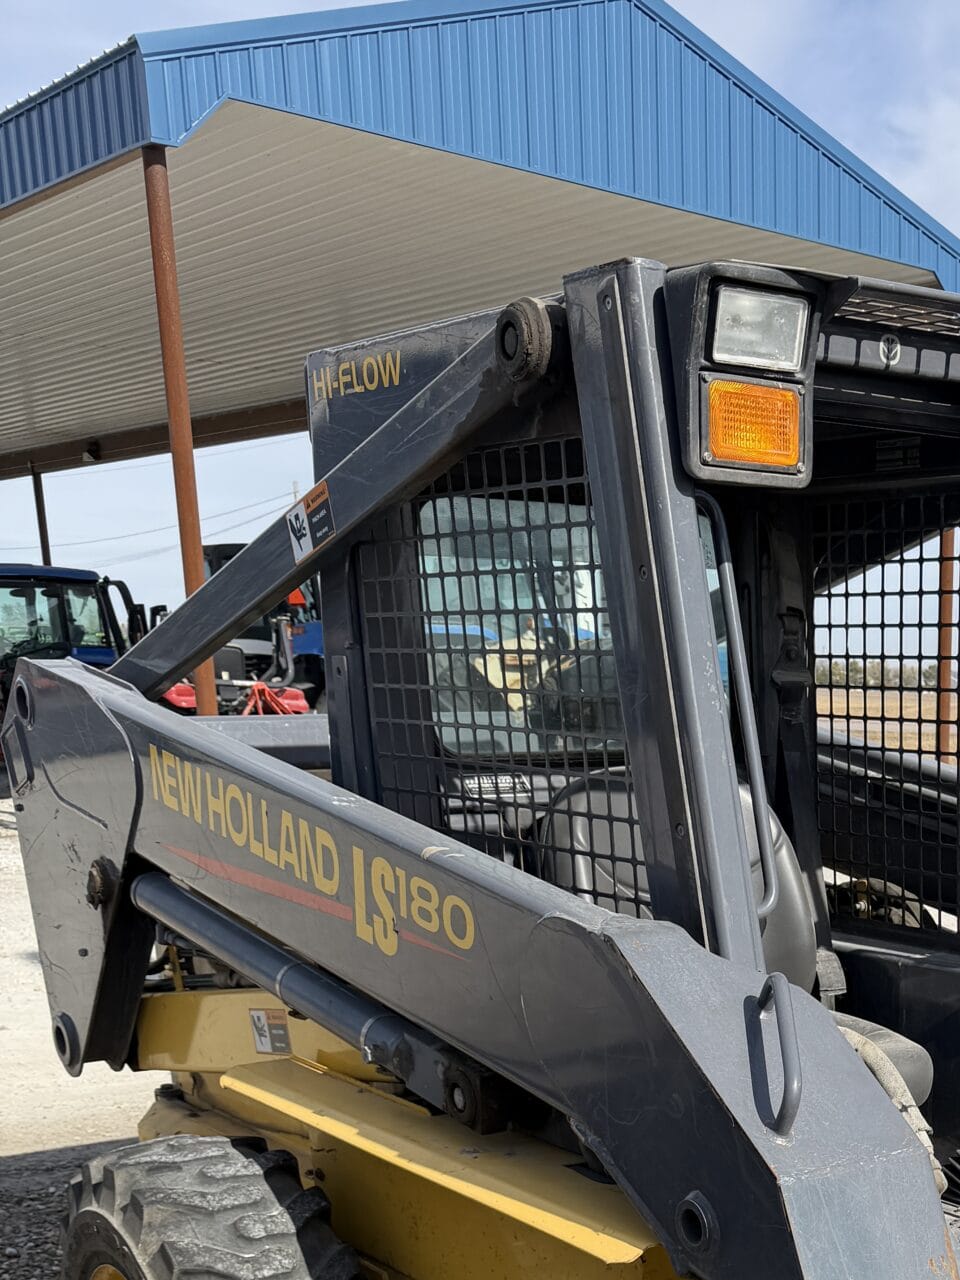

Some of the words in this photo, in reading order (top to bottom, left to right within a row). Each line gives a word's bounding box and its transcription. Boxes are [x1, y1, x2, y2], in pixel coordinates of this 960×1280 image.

[313, 350, 400, 401] HI-FLOW
[150, 743, 202, 825] NEW
[206, 772, 339, 896] HOLLAND
